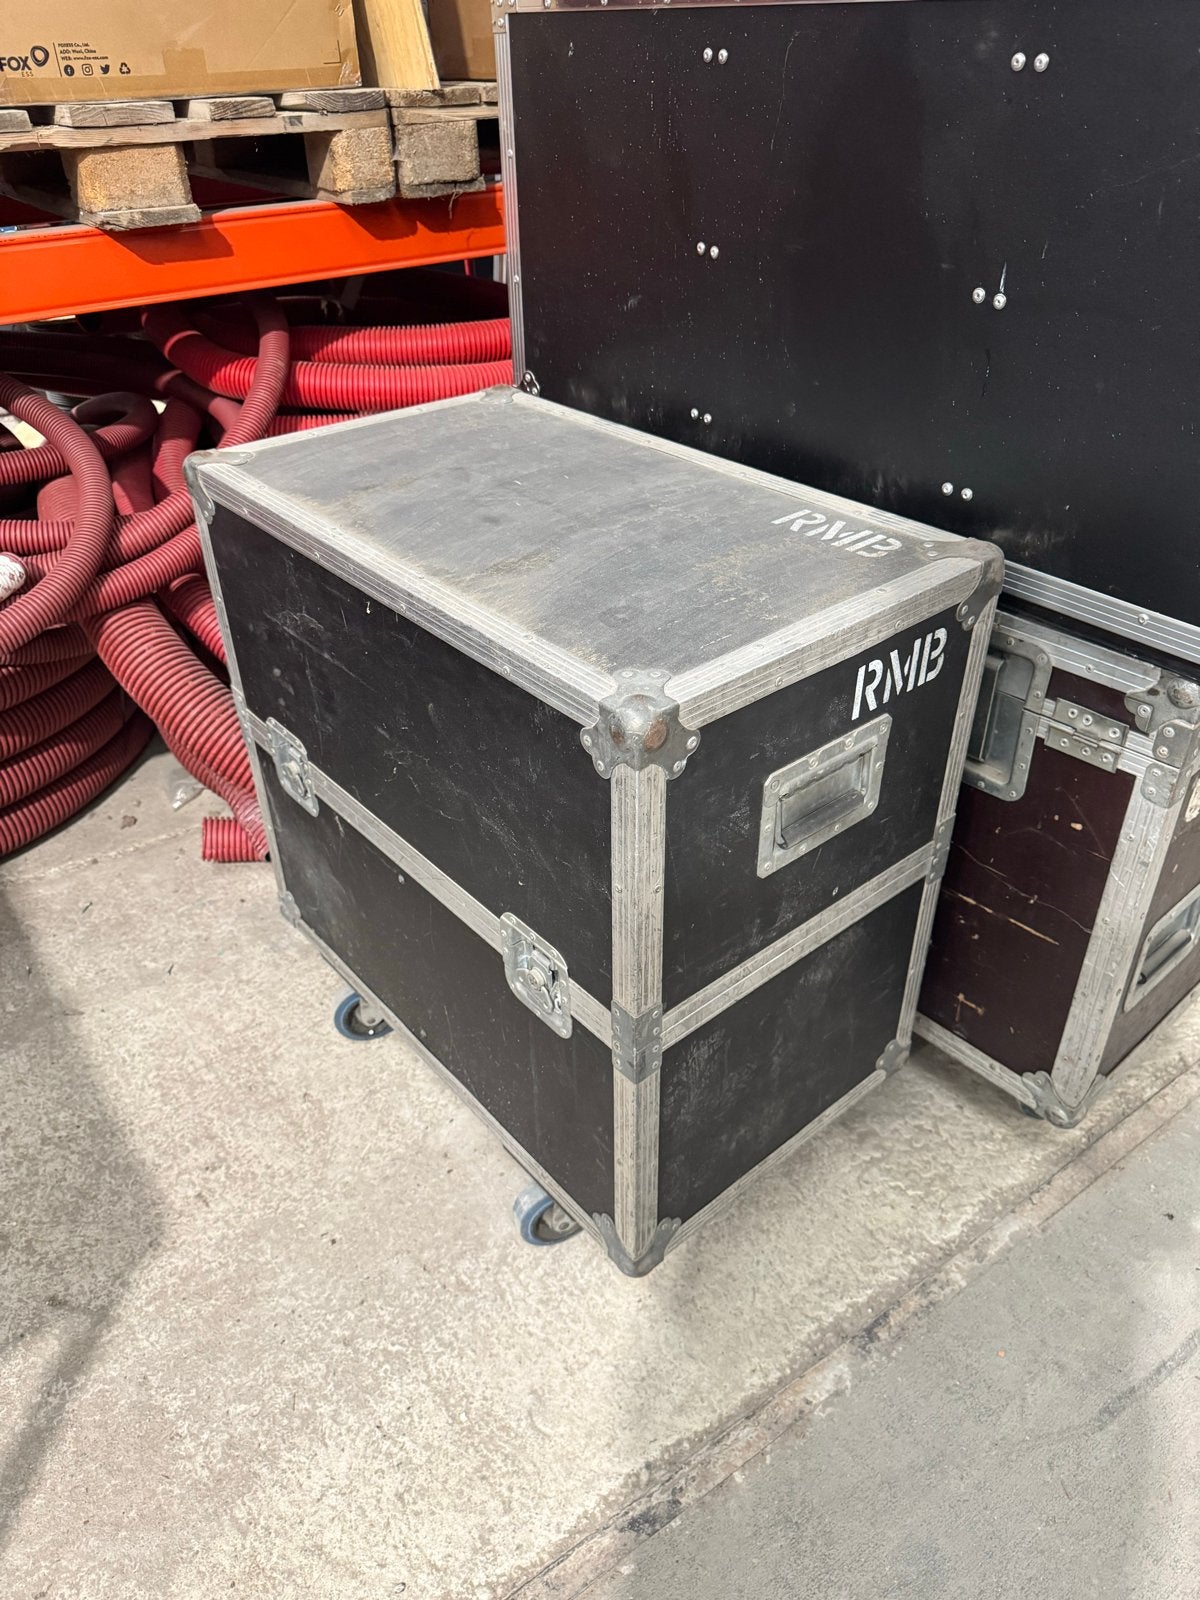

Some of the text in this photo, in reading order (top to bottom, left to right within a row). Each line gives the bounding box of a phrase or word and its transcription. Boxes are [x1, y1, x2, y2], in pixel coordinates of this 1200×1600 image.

[0, 56, 32, 72] FOX
[771, 508, 903, 558] RMB
[851, 627, 948, 721] RMB
